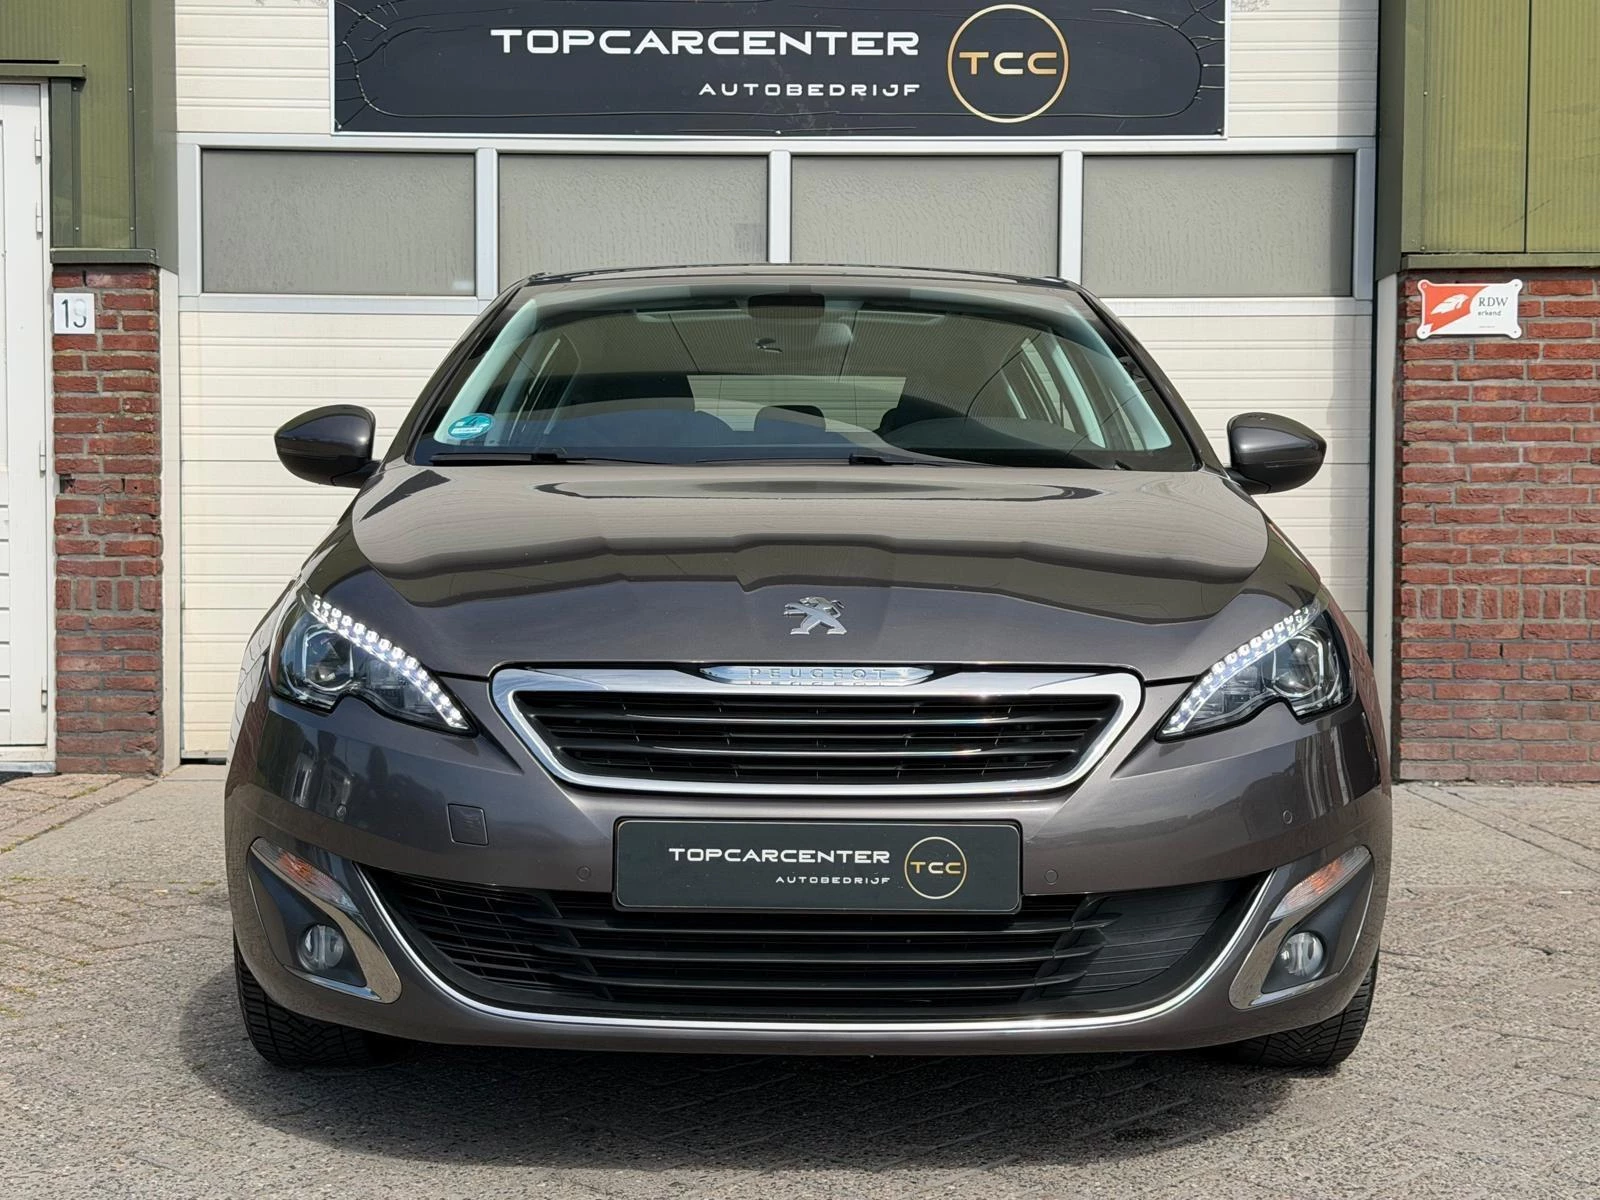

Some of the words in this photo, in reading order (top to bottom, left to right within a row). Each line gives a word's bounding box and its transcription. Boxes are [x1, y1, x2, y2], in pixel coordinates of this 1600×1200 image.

[490, 29, 920, 56] TOPCARCENTER
[959, 51, 1059, 75] TCC
[699, 82, 921, 98] AUTOBEDRIJF
[1478, 296, 1509, 307] RDW
[750, 667, 885, 679] PEUGEOT
[669, 848, 891, 864] TOPCARCENTER
[910, 861, 962, 875] TCC
[775, 876, 891, 885] AUTOBEDRIJF
